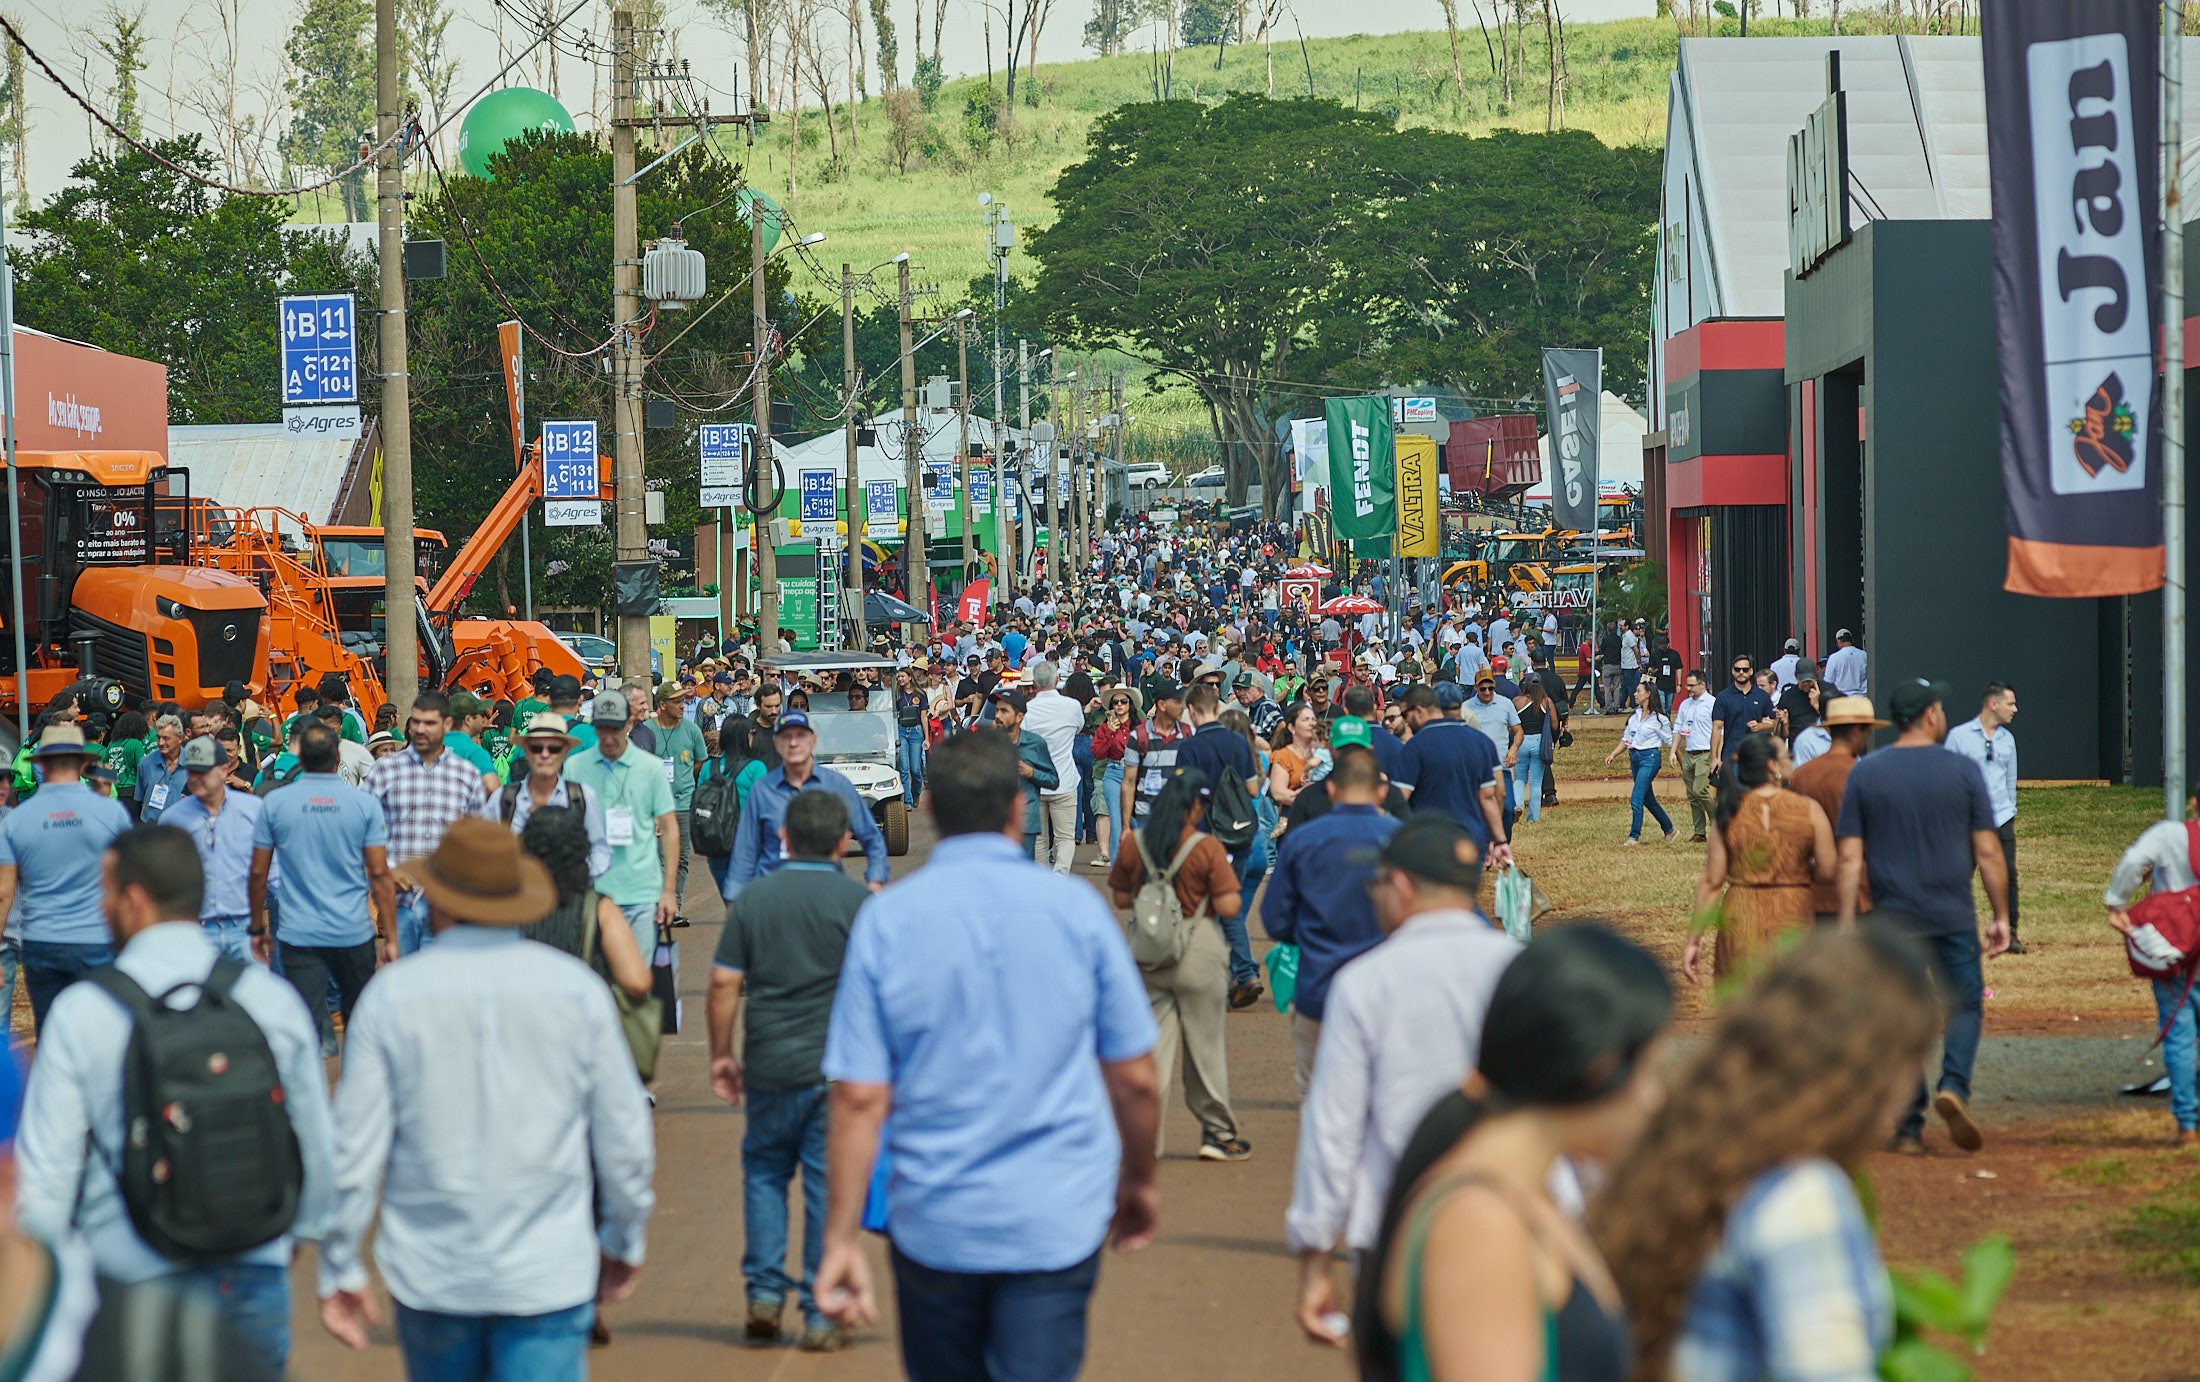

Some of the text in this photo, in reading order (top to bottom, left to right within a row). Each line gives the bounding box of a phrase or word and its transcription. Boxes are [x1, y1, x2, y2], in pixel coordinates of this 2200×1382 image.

[2057, 58, 2129, 334] Jan
[298, 307, 345, 337] B 11
[305, 356, 340, 381] C 12
[289, 370, 340, 392] A 10
[304, 416, 355, 432] Agres
[556, 430, 592, 451] B 12
[710, 429, 738, 445] B 13
[560, 465, 585, 483] C 13
[1351, 419, 1374, 518] FENDT
[548, 476, 585, 491] A 11
[810, 476, 832, 490] B 14
[874, 484, 893, 495] B 15
[712, 493, 740, 502] Agres
[1402, 453, 1424, 548] VALTRA
[114, 511, 135, 527] 0%
[560, 507, 598, 520] Agres
